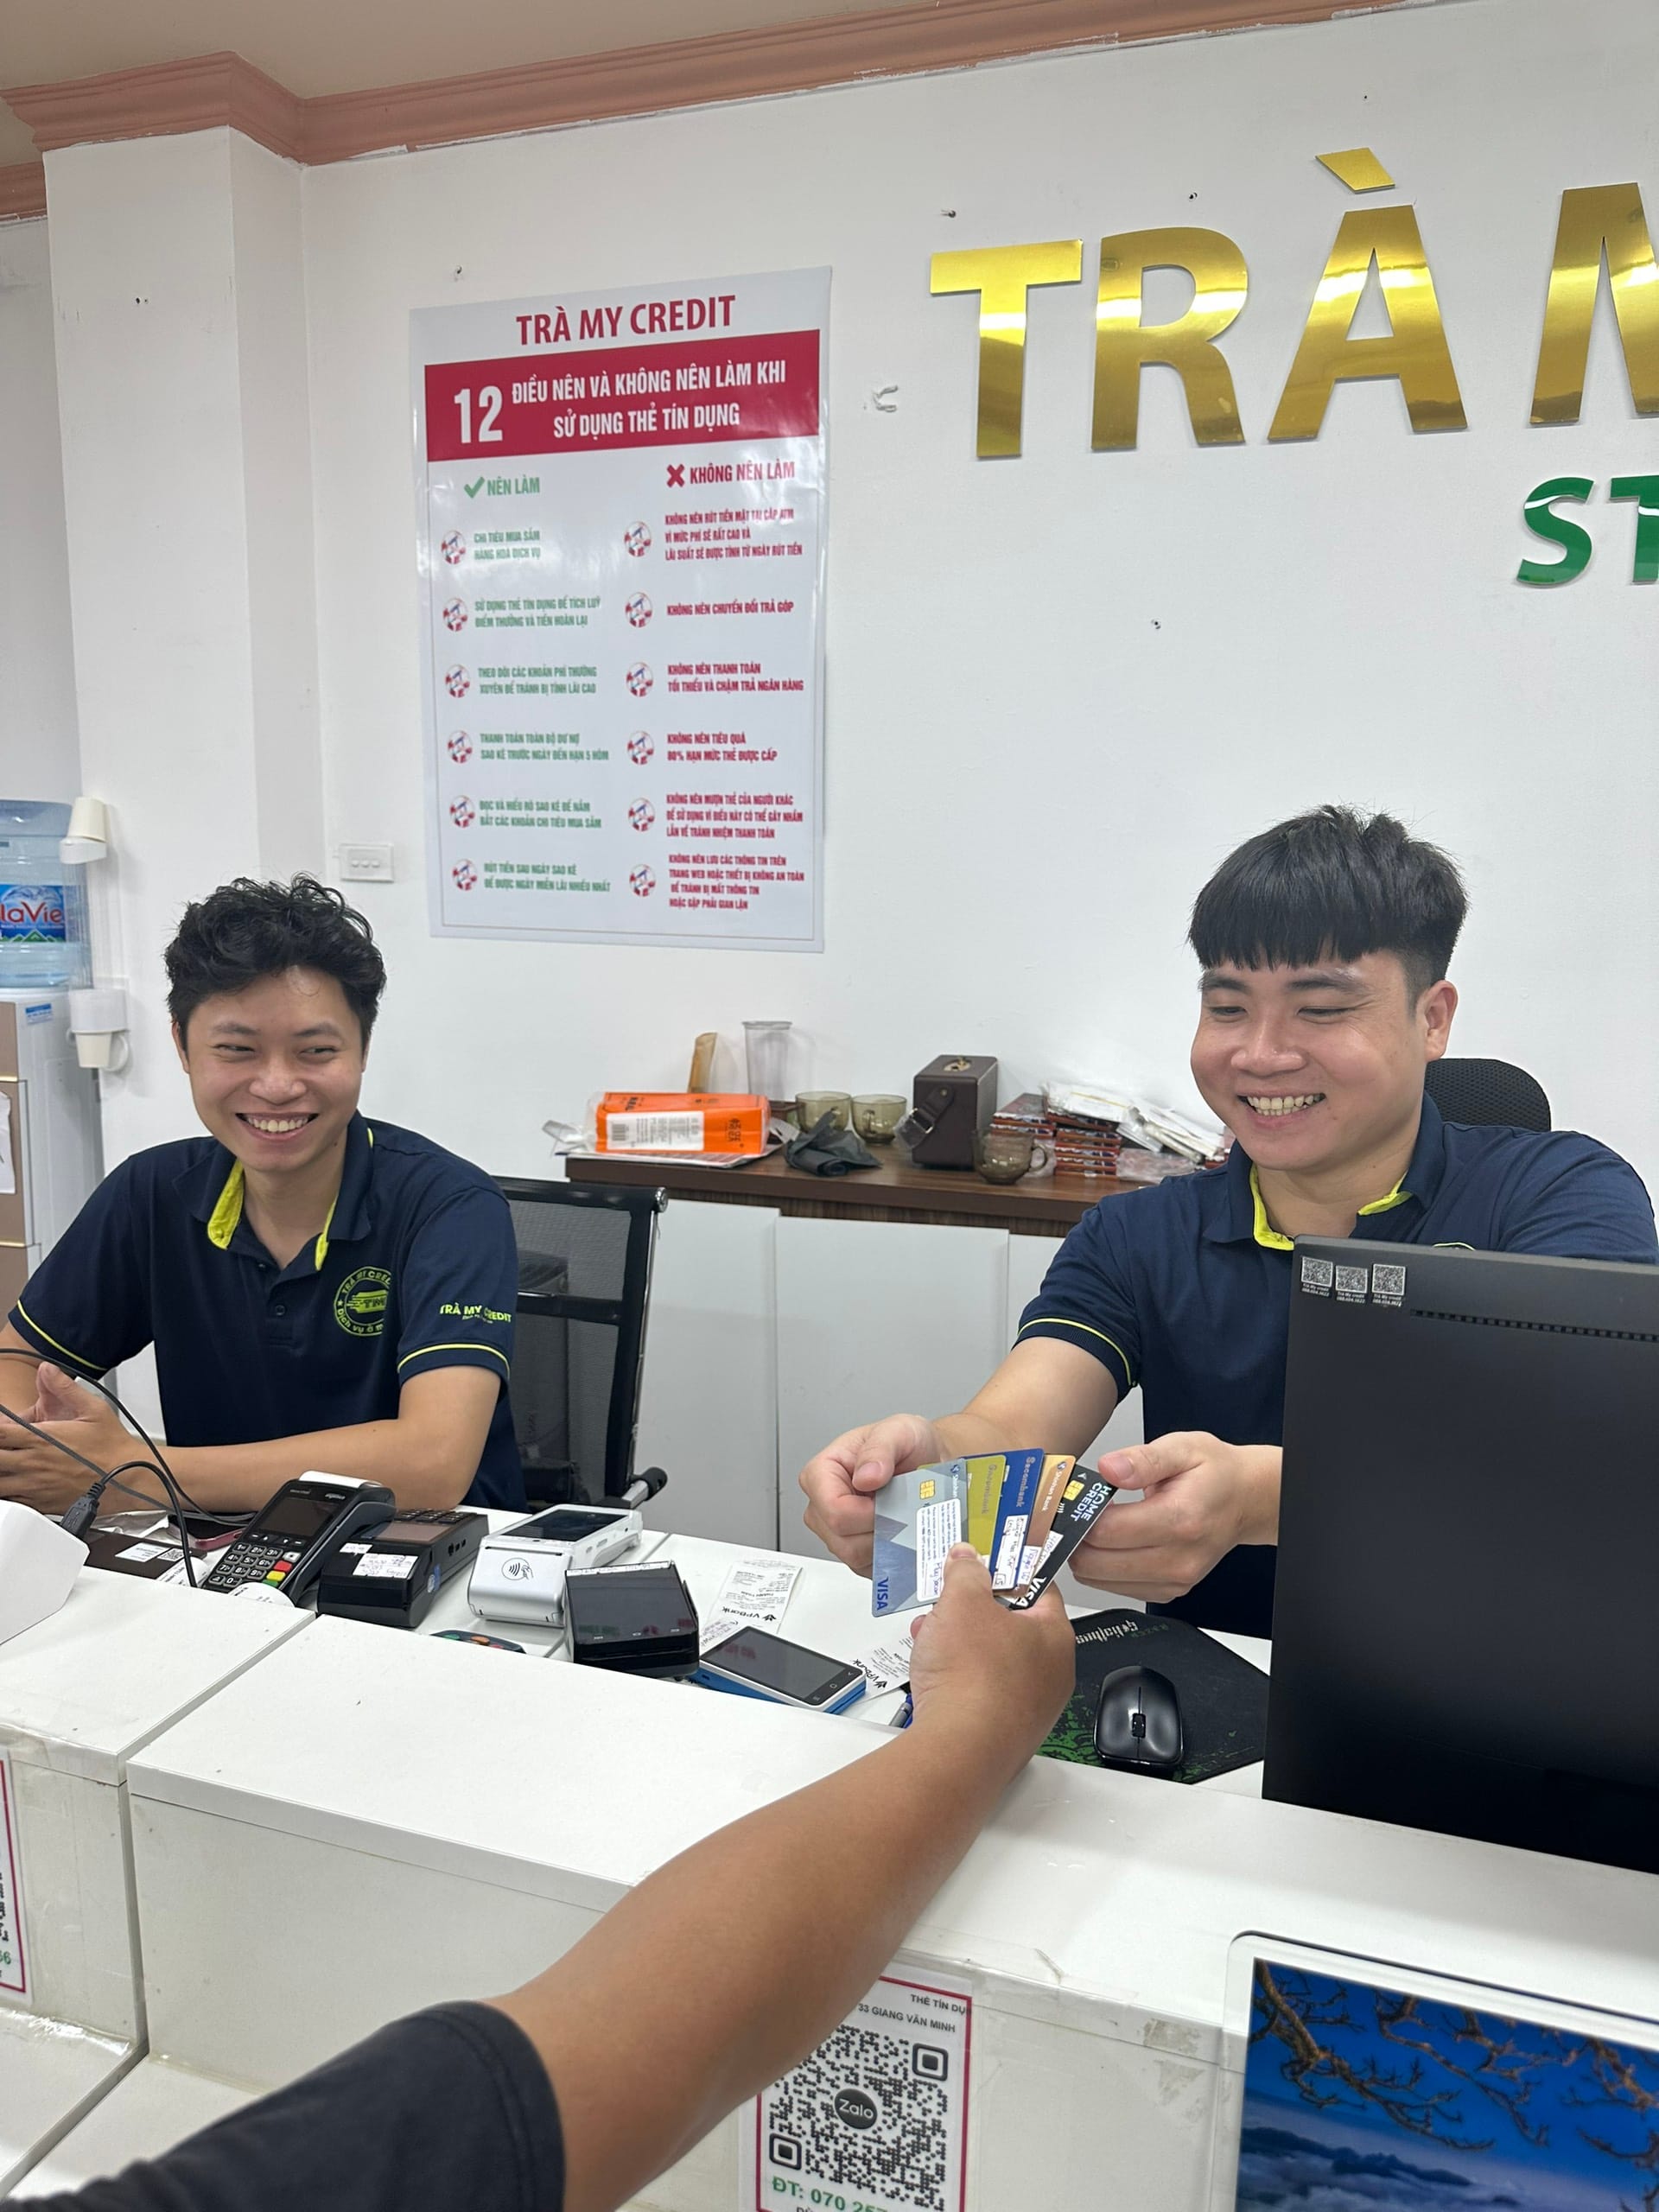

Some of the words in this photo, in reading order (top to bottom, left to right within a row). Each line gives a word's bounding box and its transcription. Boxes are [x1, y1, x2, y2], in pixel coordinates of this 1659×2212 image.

[929, 147, 1468, 458] TRÀ
[516, 306, 571, 346] TRÀ
[579, 306, 623, 340] MY
[630, 295, 736, 335] CREDIT
[512, 376, 548, 404] ĐIỀU
[552, 373, 585, 401] NÊN
[589, 371, 611, 398] VÀ
[615, 367, 671, 396] KHÔNG
[676, 363, 710, 391] NÊN
[715, 359, 752, 388] LÀM
[758, 360, 786, 385] KHI
[454, 385, 503, 444] 12
[553, 410, 576, 438] SỬ
[579, 412, 623, 441] DỤNG
[627, 402, 658, 432] THẺ
[662, 403, 690, 429] TÍN
[693, 403, 740, 430] DỤNG
[487, 476, 512, 496] NÊN
[515, 474, 540, 494] LÀM
[690, 462, 733, 484] KHÔNG
[736, 460, 764, 481] NÊN
[766, 458, 795, 480] LÀM
[463, 1305, 482, 1315] MY
[1071, 1482, 1103, 1522] CREDIT
[1081, 1485, 1113, 1522] HOME
[876, 1577, 889, 1611] VISA
[1018, 1576, 1047, 1608] VISA
[872, 2005, 904, 2021] GIANG
[906, 2013, 927, 2026] VĂN
[930, 2019, 956, 2033] MINH
[933, 1998, 949, 2011] TÍN
[839, 2098, 874, 2119] Zalo
[772, 2176, 804, 2200] ĐT:
[810, 2189, 845, 2211] 070
